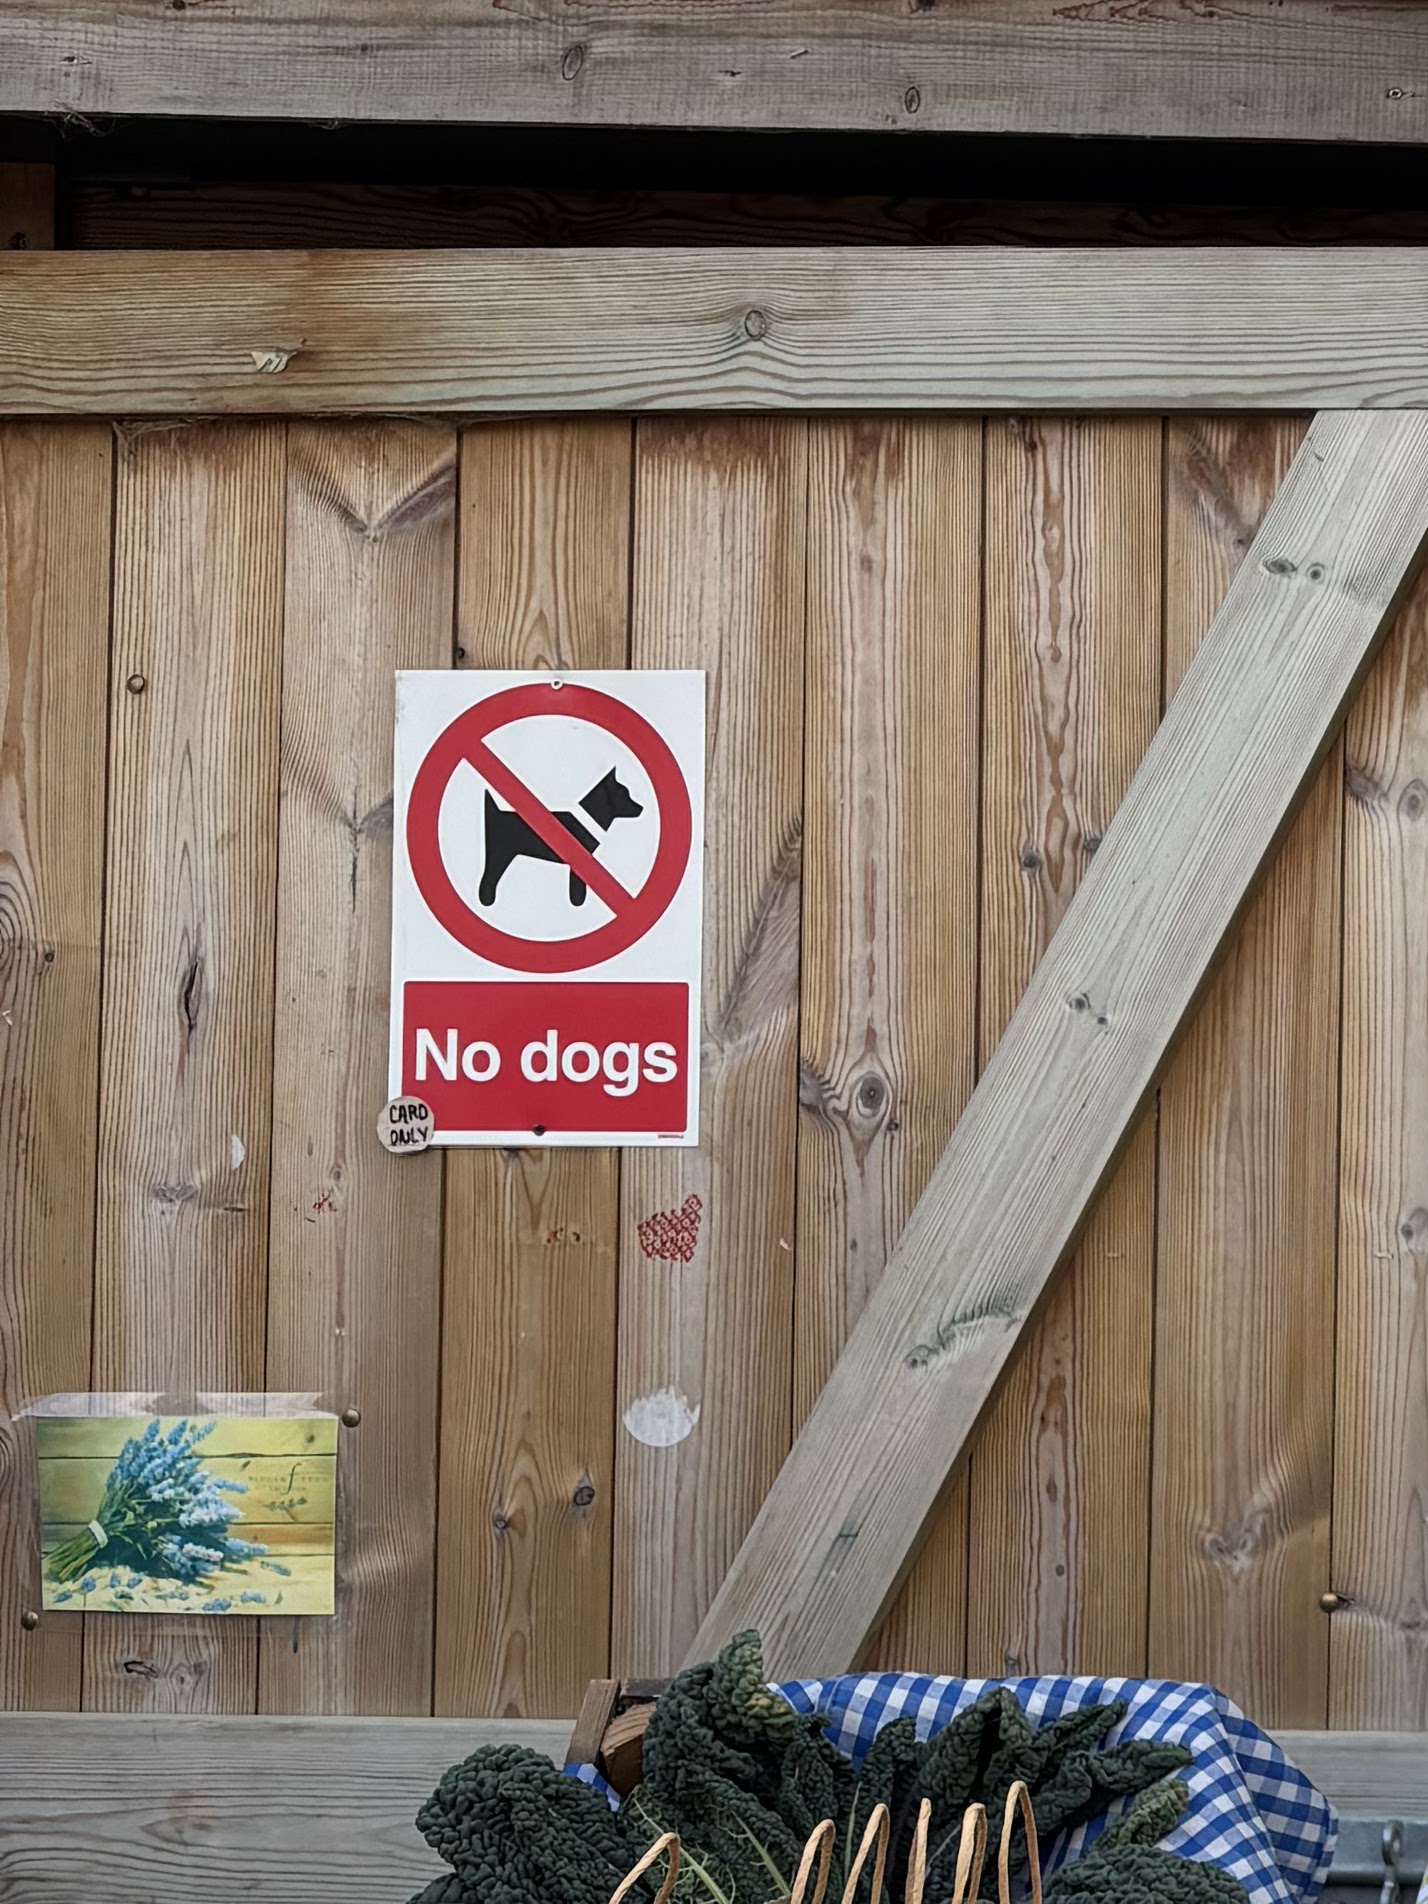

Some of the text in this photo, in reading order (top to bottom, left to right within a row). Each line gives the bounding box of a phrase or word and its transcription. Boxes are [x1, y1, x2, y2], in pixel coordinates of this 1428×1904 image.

[415, 1027, 679, 1098] No dogs
[389, 1103, 429, 1125] CARD
[390, 1126, 429, 1147] ONLY
